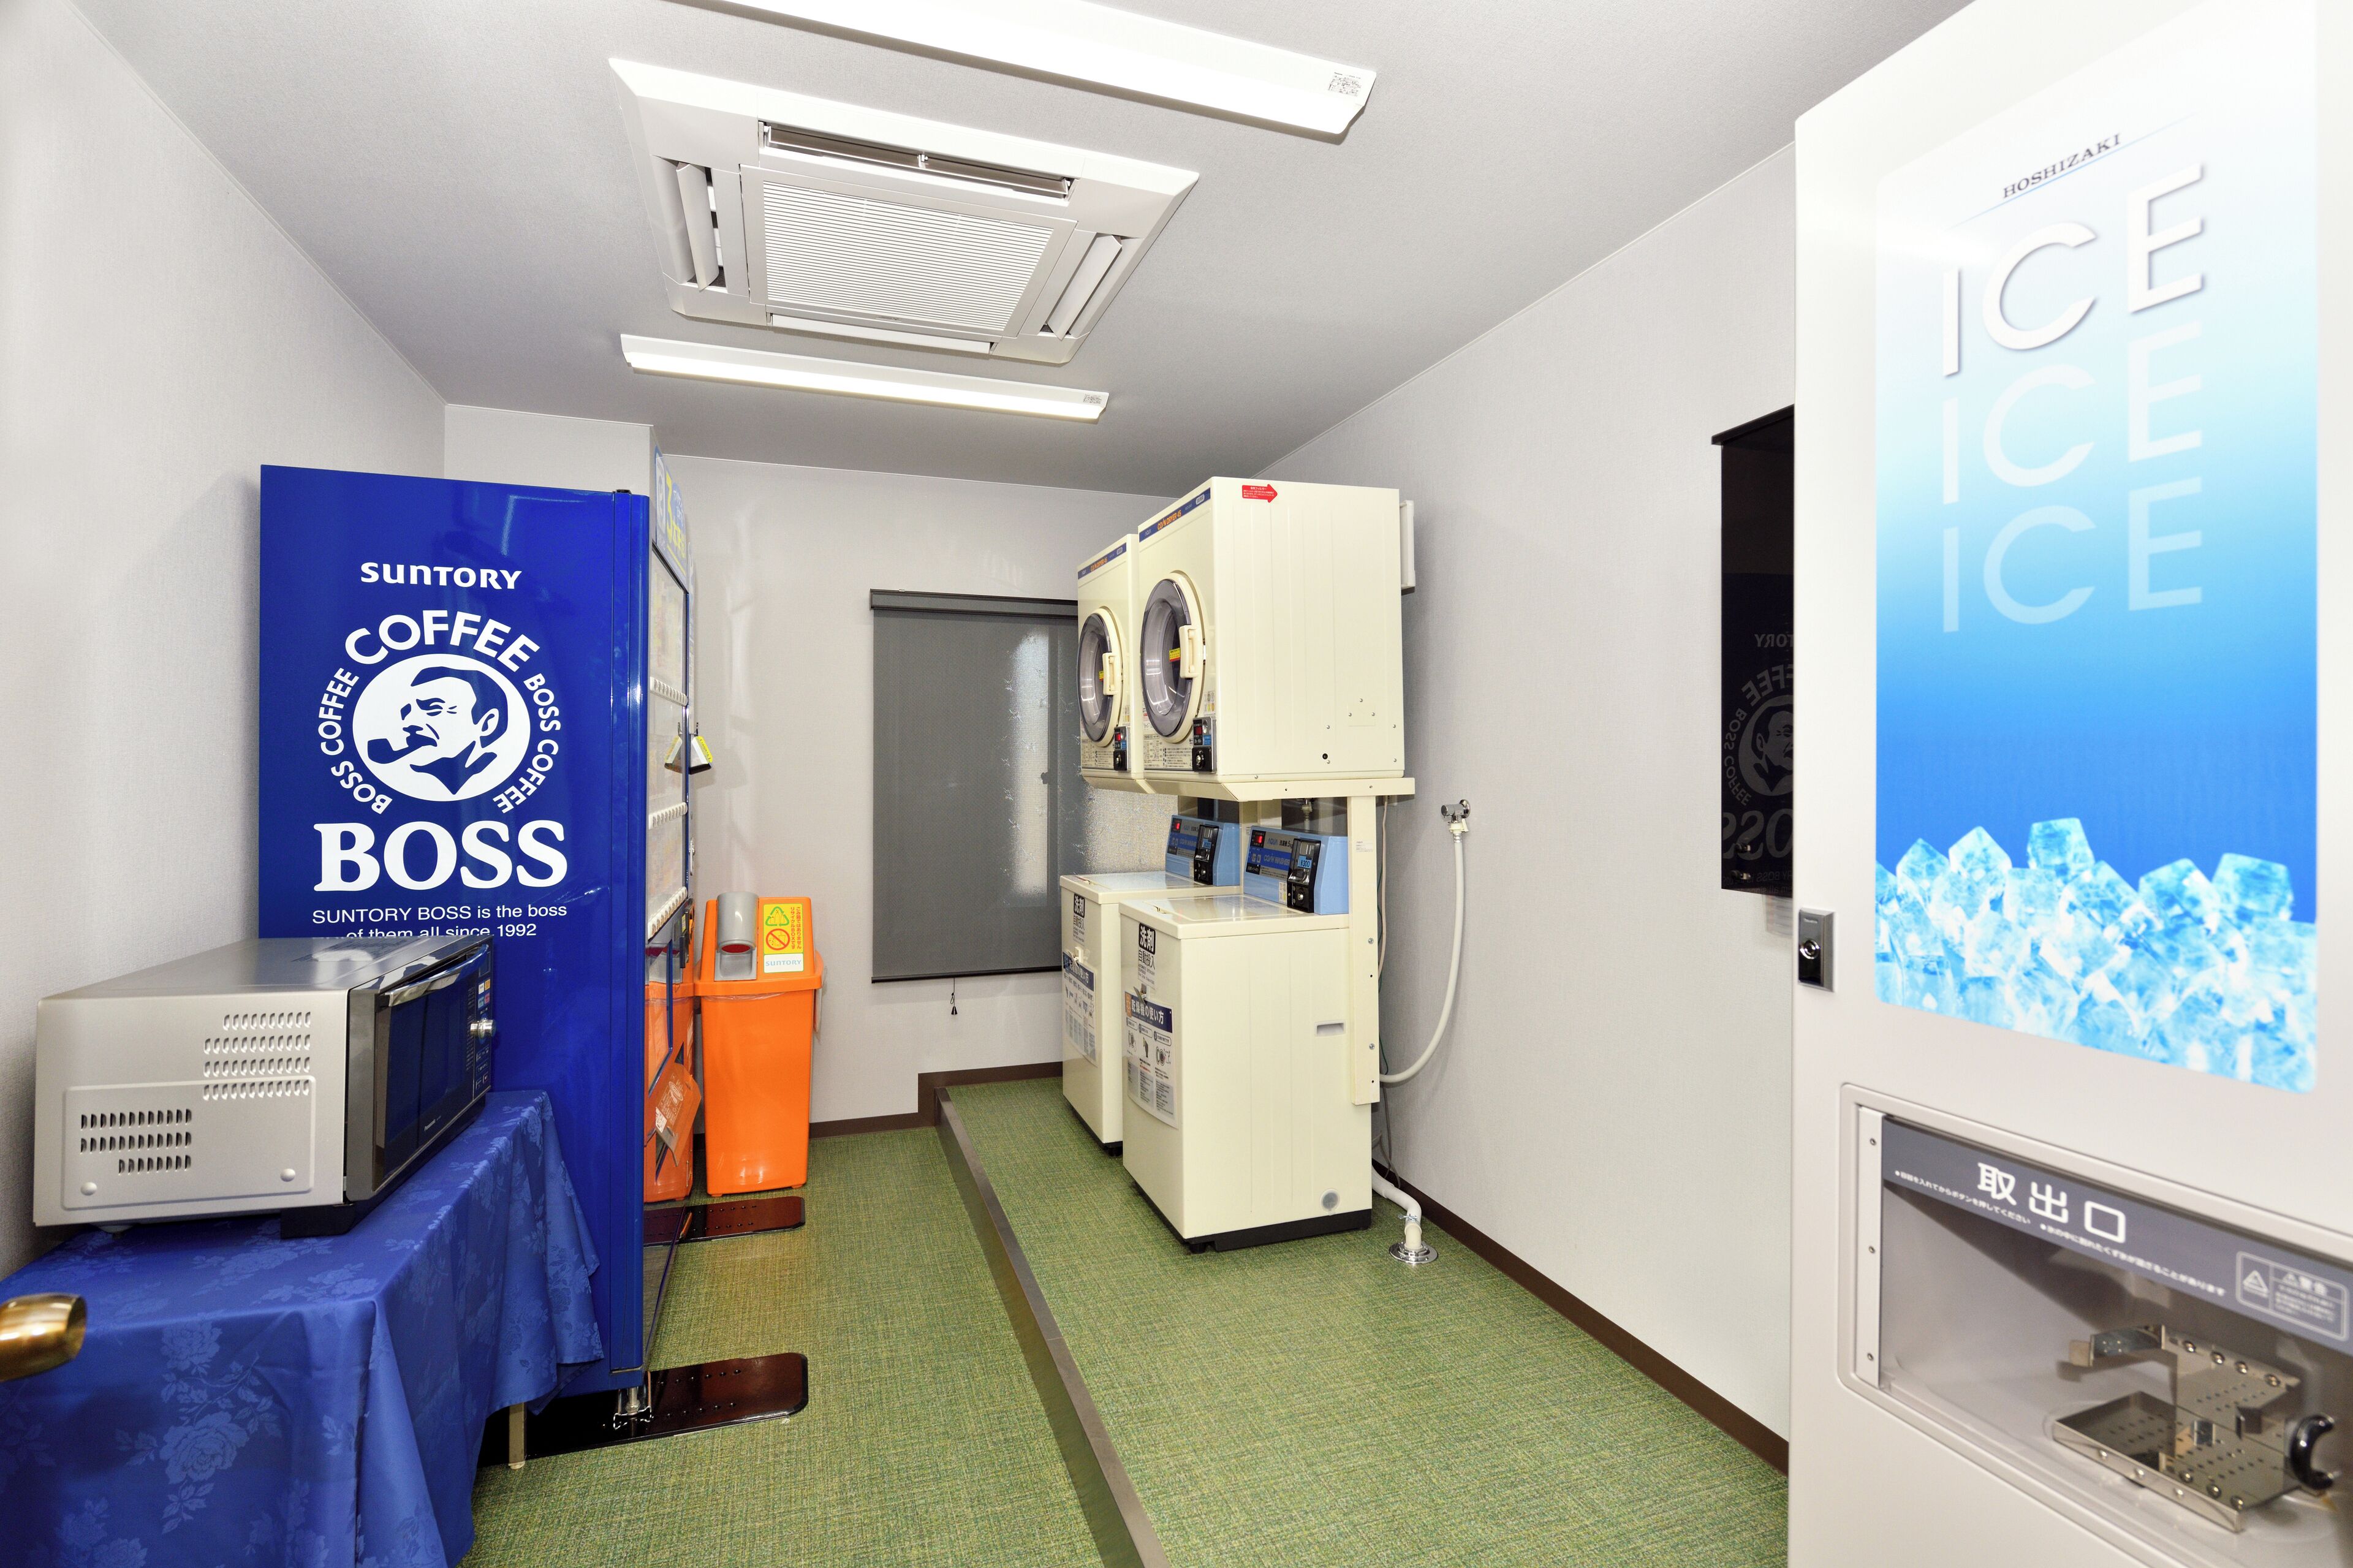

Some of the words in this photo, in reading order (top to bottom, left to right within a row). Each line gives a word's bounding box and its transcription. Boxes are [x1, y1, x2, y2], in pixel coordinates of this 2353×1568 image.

[2003, 133, 2121, 200] HOSHIZAKI
[1943, 161, 2206, 378] ICE
[1942, 319, 2202, 505] ICE
[1943, 475, 2202, 633] ICE
[345, 610, 540, 673] COFFEE
[318, 668, 359, 755] COFFEE
[524, 673, 561, 731] BOSS
[331, 760, 392, 814] BOSS
[493, 740, 559, 813] COFFEE
[313, 820, 567, 892] BOSS
[313, 907, 412, 924] SUNTORY
[418, 906, 471, 920] BOSS
[478, 906, 491, 918] is
[496, 904, 523, 918] the
[528, 904, 567, 917] boss
[346, 928, 363, 937] of
[420, 926, 439, 936] all
[446, 925, 490, 936] since
[497, 923, 537, 937] 1992
[1140, 925, 1154, 952] 洗剤
[1139, 949, 1156, 970] 自動投入
[1977, 1162, 2126, 1244] 取出口
